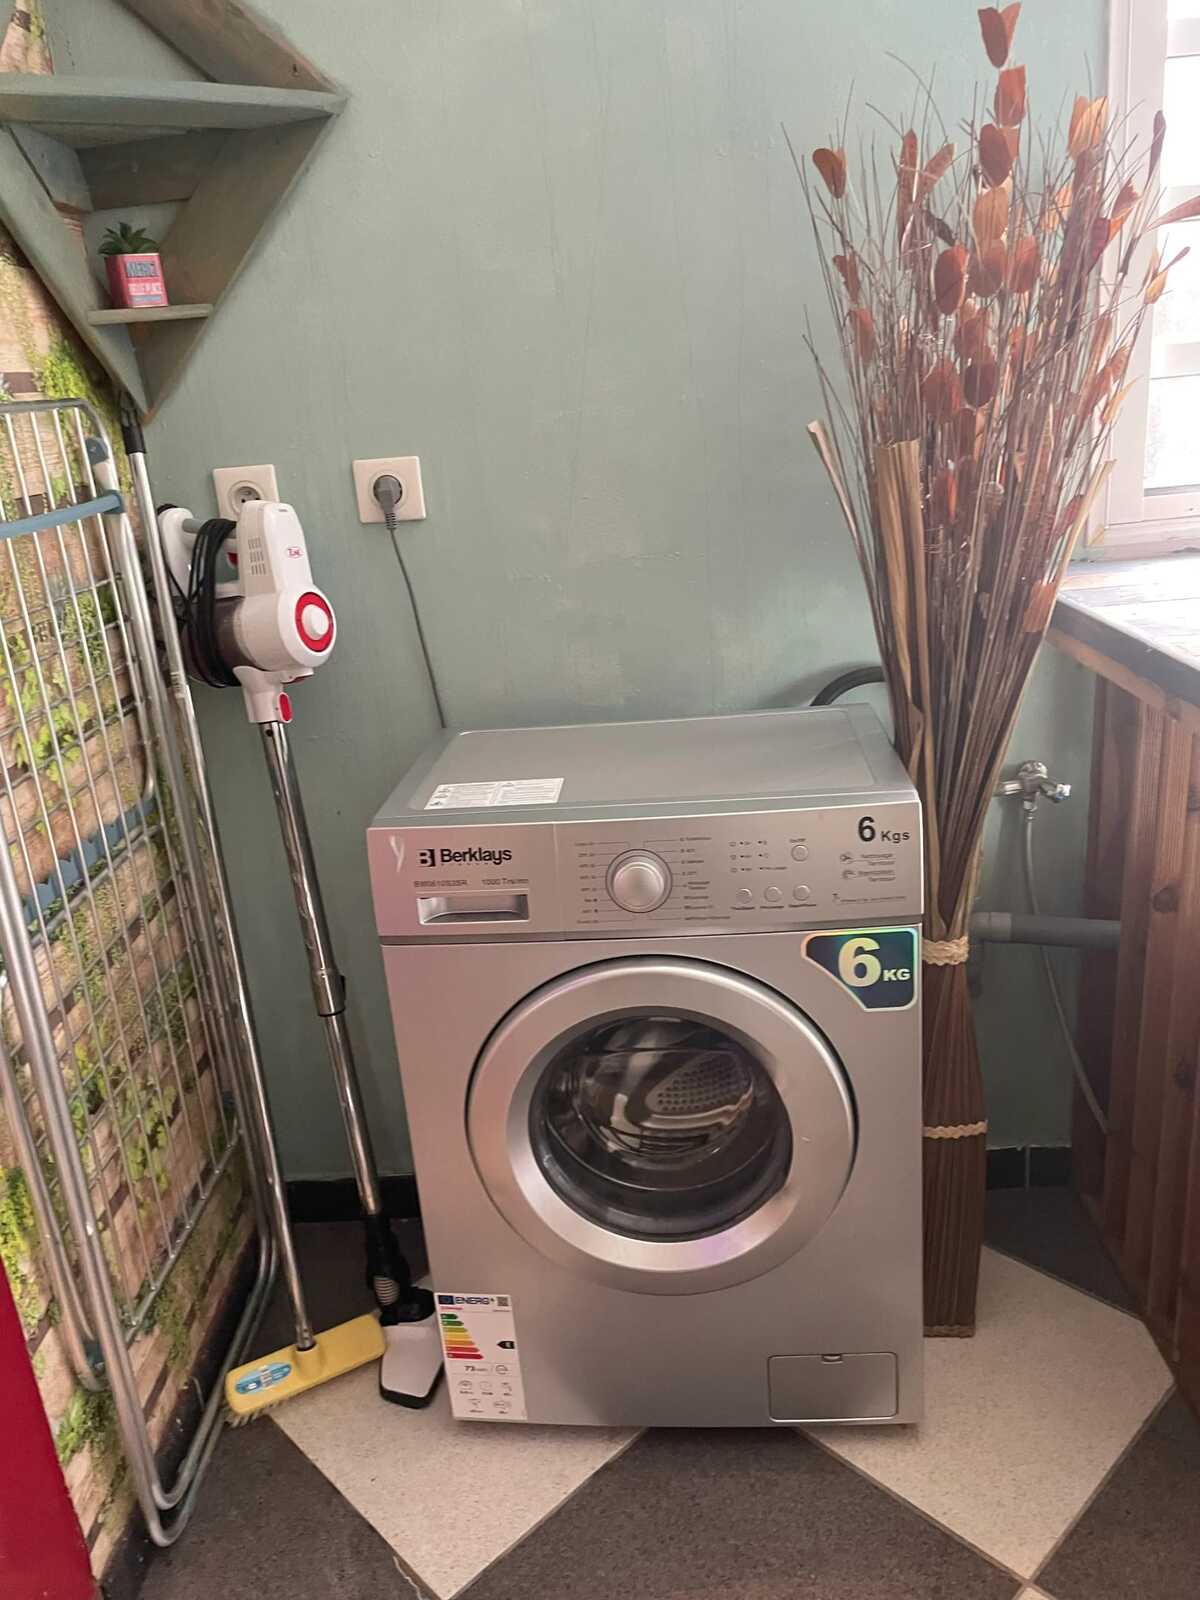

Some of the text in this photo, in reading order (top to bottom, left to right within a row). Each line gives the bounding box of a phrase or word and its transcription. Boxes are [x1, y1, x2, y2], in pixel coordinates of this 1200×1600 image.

[857, 816, 911, 844] 6 Kgs
[439, 847, 513, 866] Berklays
[838, 937, 912, 988] 6 KG
